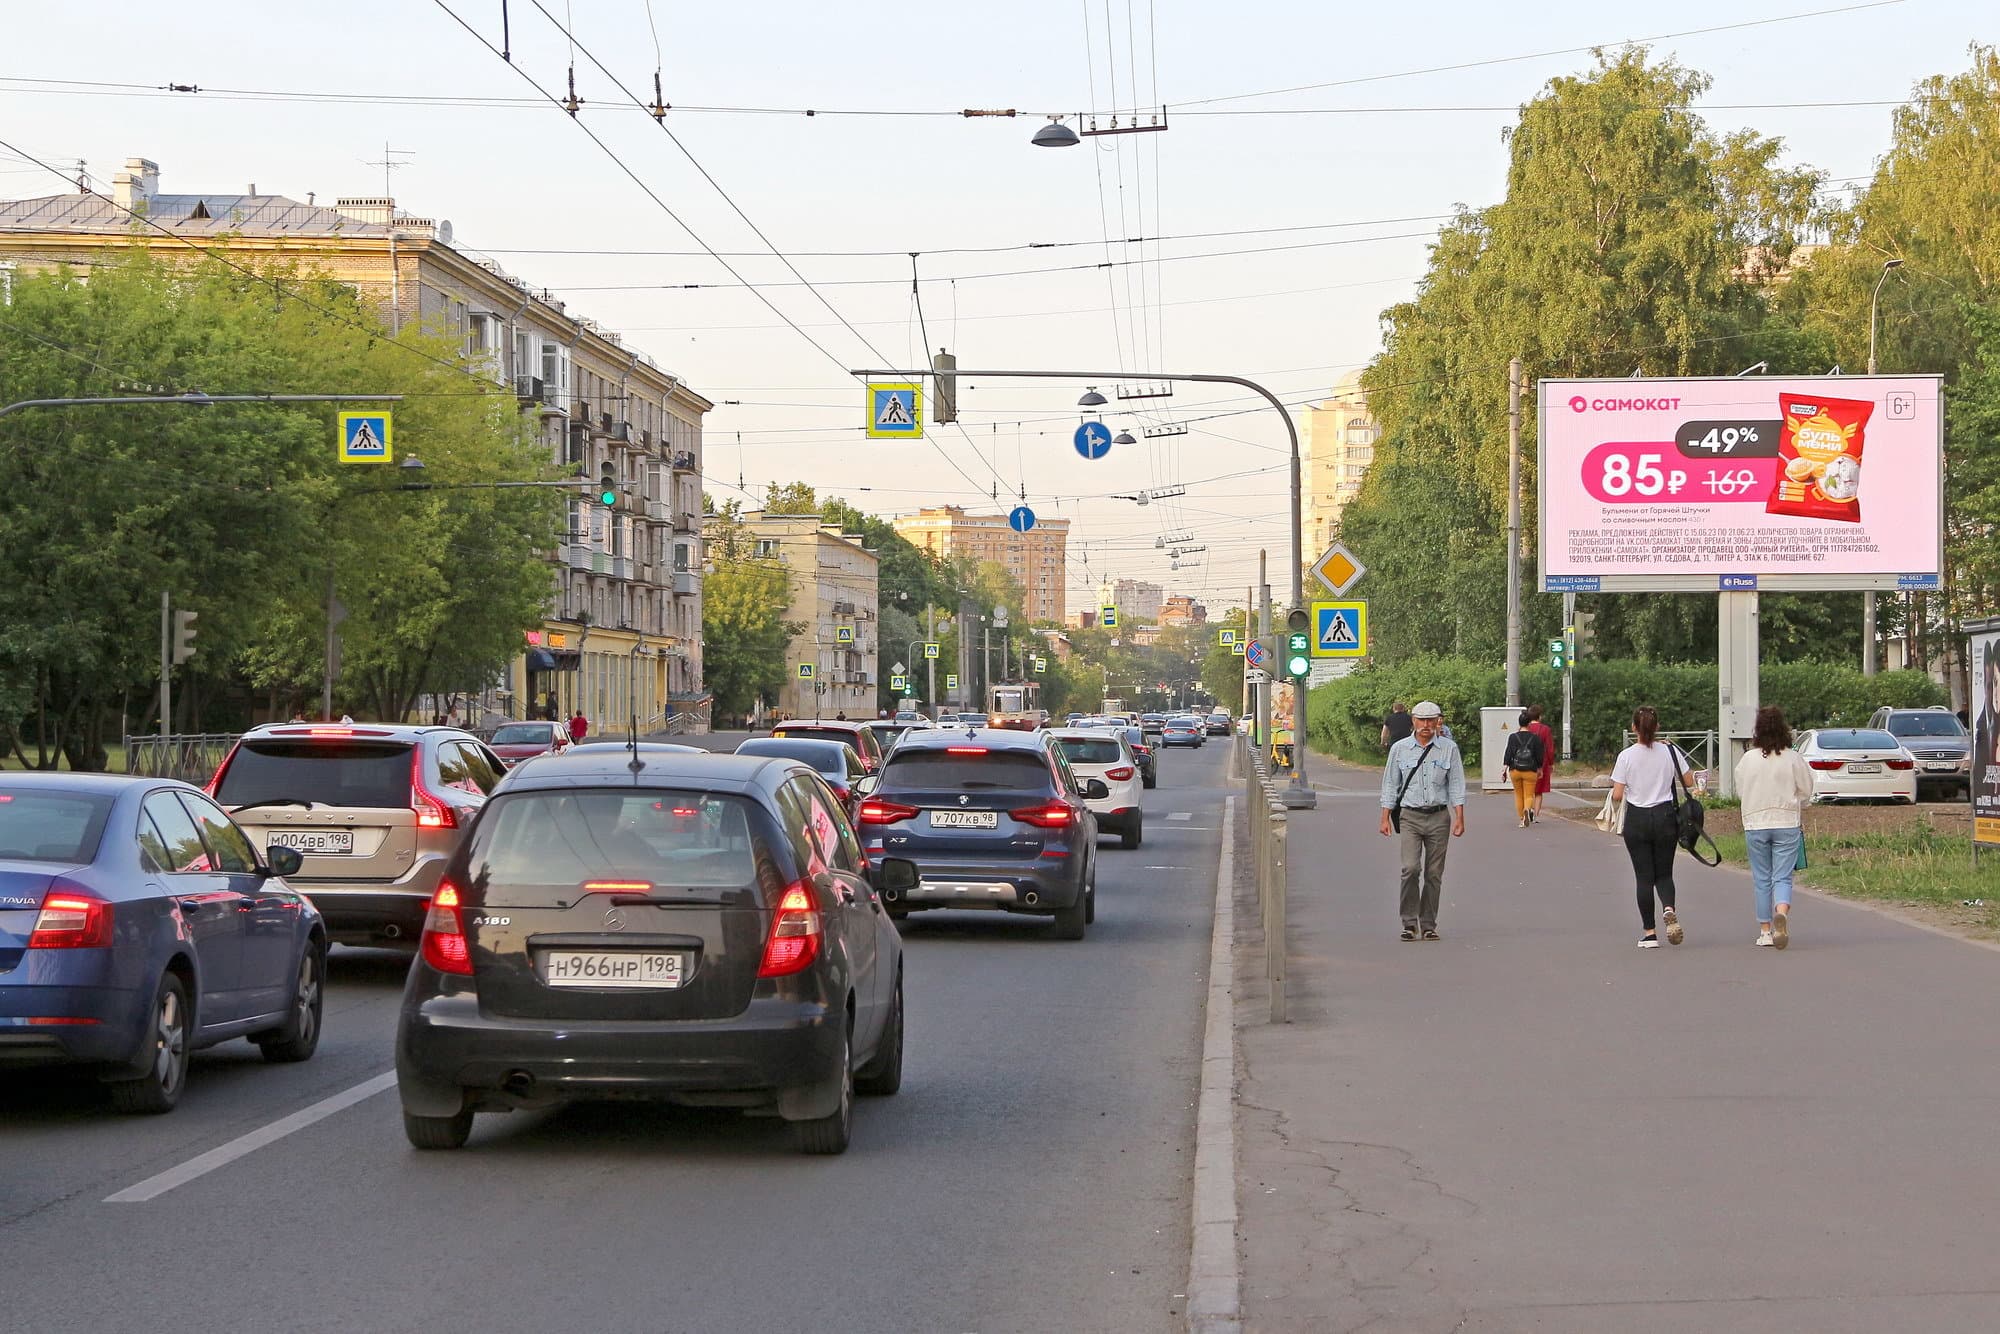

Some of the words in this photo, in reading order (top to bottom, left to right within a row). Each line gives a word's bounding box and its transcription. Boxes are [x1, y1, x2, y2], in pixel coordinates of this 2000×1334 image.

[1592, 398, 1681, 411] самокат
[1893, 397, 1910, 415] 6+
[1688, 427, 1759, 453] -49%
[1798, 428, 1841, 443] буль
[1702, 469, 1757, 495] 169
[1602, 507, 1639, 516] Бульмени
[1650, 506, 1681, 516] Горячей
[1682, 506, 1711, 515] Штучки
[1601, 529, 1648, 538] ПРЕДЛОЖЕНИЕ
[1649, 528, 1683, 537] ДЕЙСТВУЕТ
[1684, 528, 1690, 537] С
[1690, 528, 1716, 537] 15.06.23
[1717, 528, 1728, 537] ПО
[1757, 527, 1798, 536] КОЛИЧЕСТВО
[1799, 527, 1823, 536] ТОВАРА
[1569, 537, 1615, 547] ПОДРОБНОСТИ
[1616, 537, 1625, 546] НА
[1704, 536, 1726, 545] ВРЕМЯ
[1726, 536, 1732, 545] И
[1733, 536, 1752, 545] ЗОНЫ
[1753, 535, 1787, 546] ДОСТАВКИ
[1788, 535, 1823, 545] УТОЧНЯЙТЕ
[1823, 535, 1829, 544] В
[1829, 535, 1871, 544] МОБИЛЬНОМ
[1569, 546, 1612, 555] ПРИЛОЖЕНИИ
[1697, 545, 1734, 554] ПРОДАВЕЦ
[1735, 545, 1749, 553] ООО
[1750, 544, 1779, 553] «УМНЫЙ
[1811, 544, 1829, 553] ОГРН
[1714, 554, 1735, 562] ЛИТЕР
[1744, 554, 1762, 562] ЭТАЖ
[1770, 553, 1812, 563] ПОМЕЩЕНИЕ
[1733, 578, 1754, 586] Russ
[1291, 637, 1307, 650] 36
[473, 916, 511, 926] A180
[644, 957, 676, 973] 198
